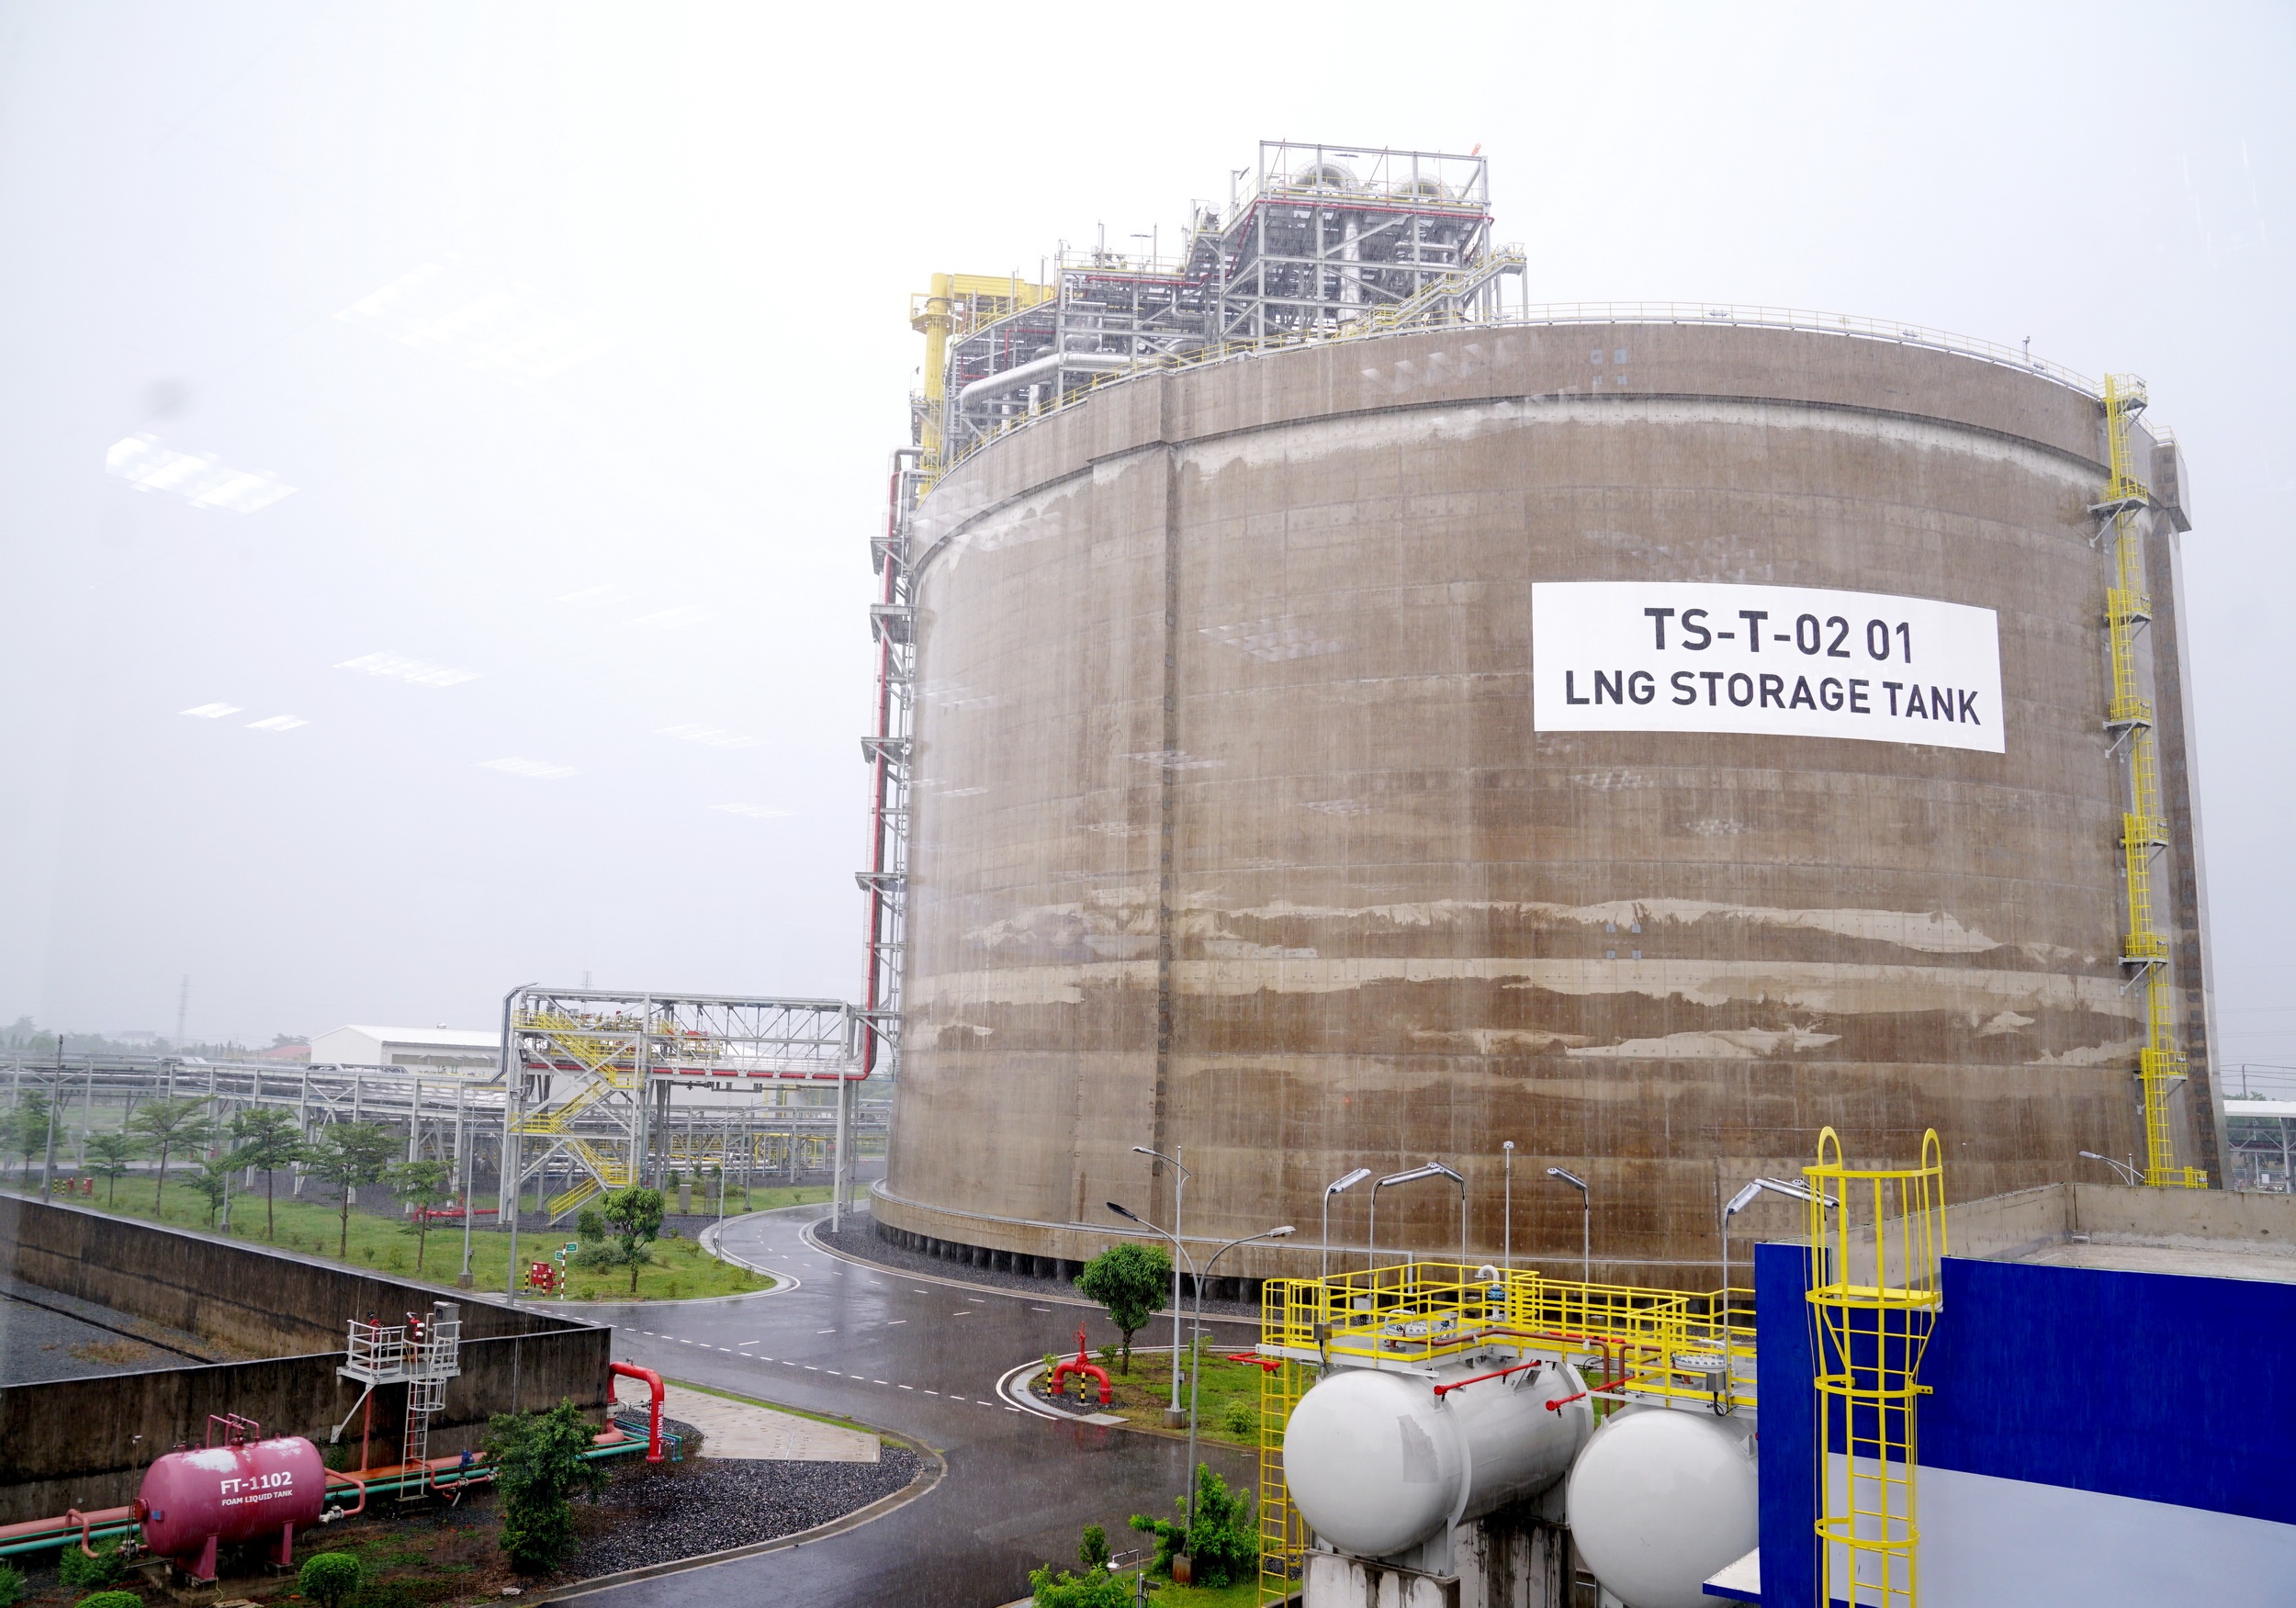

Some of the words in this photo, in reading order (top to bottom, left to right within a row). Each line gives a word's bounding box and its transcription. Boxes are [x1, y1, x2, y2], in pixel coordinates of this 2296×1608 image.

[1644, 607, 1851, 658] TS-T-02
[1866, 618, 1912, 663] 01
[1565, 670, 1656, 705] LNG
[1671, 670, 1871, 714] STORAGE
[1882, 681, 1981, 725] TANK
[220, 1471, 293, 1495] FT-1102
[221, 1497, 243, 1506] FOAM
[244, 1492, 273, 1503] LIQUID
[273, 1490, 293, 1499] TANK
